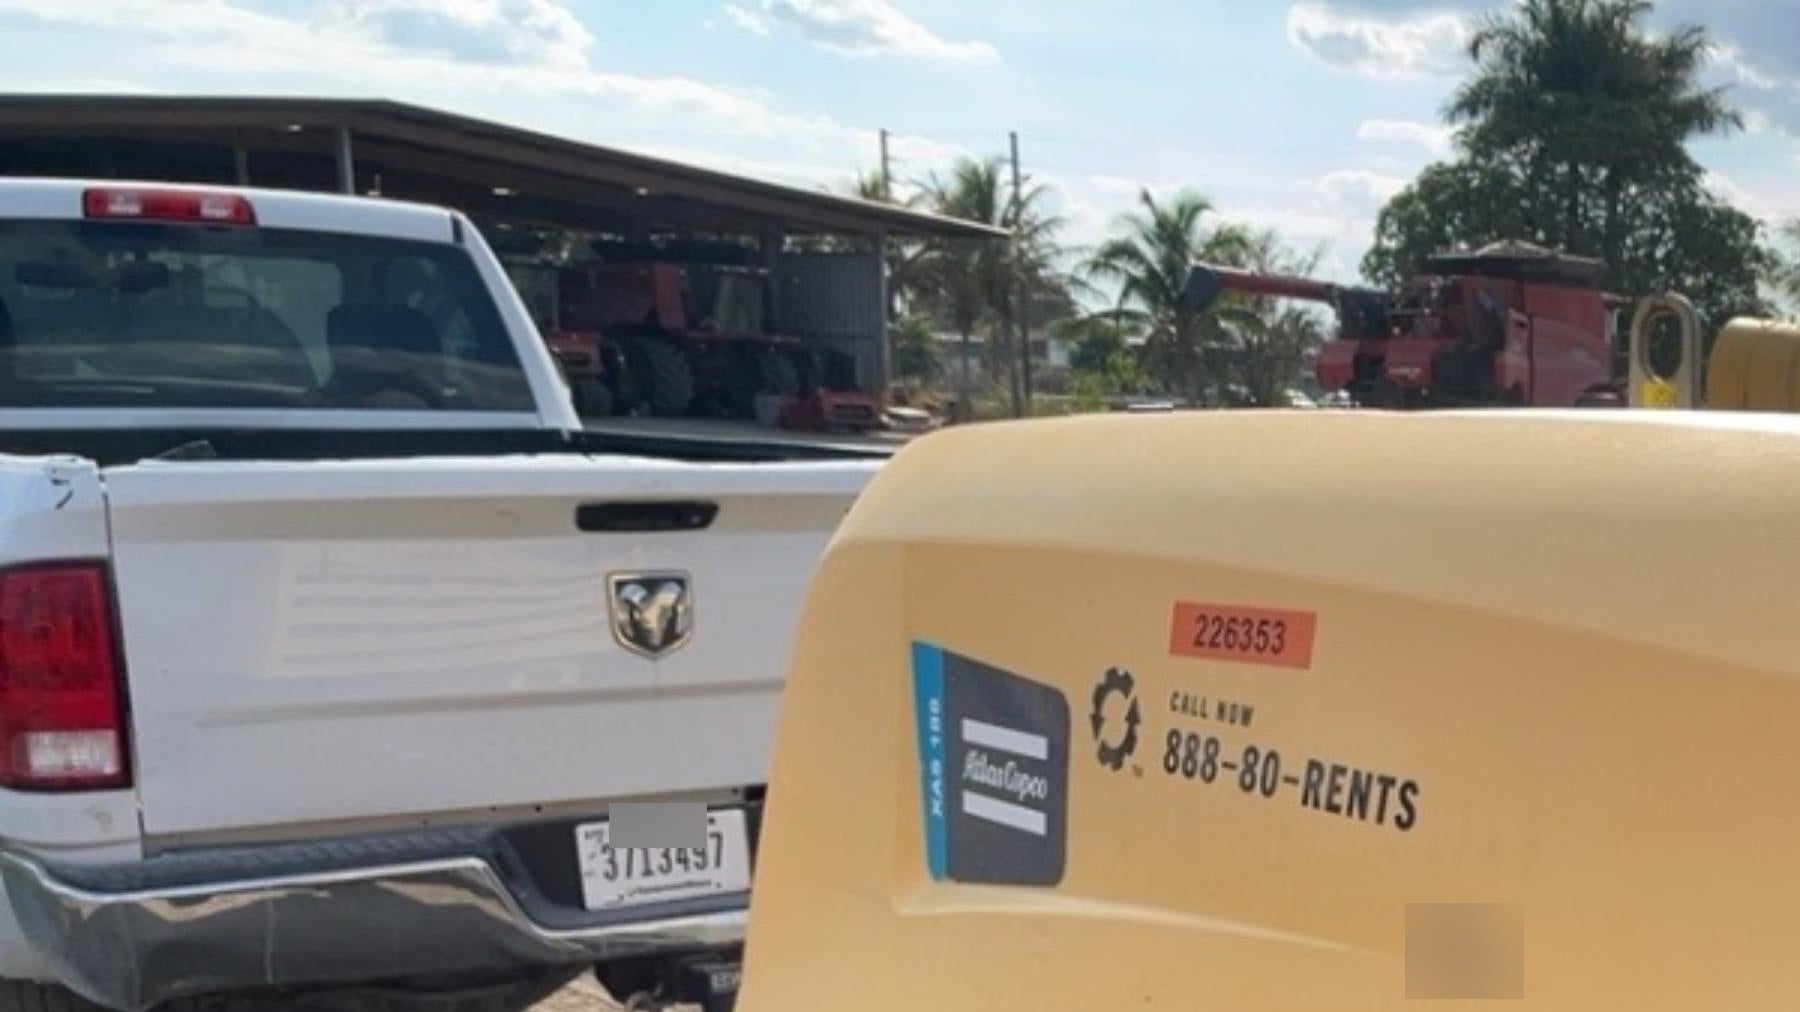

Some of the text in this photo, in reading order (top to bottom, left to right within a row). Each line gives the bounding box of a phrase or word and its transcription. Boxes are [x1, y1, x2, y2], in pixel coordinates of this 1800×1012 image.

[1192, 613, 1287, 655] 226353
[1168, 691, 1255, 727] CALL NOW
[1162, 727, 1420, 832] 888-80-RENTS
